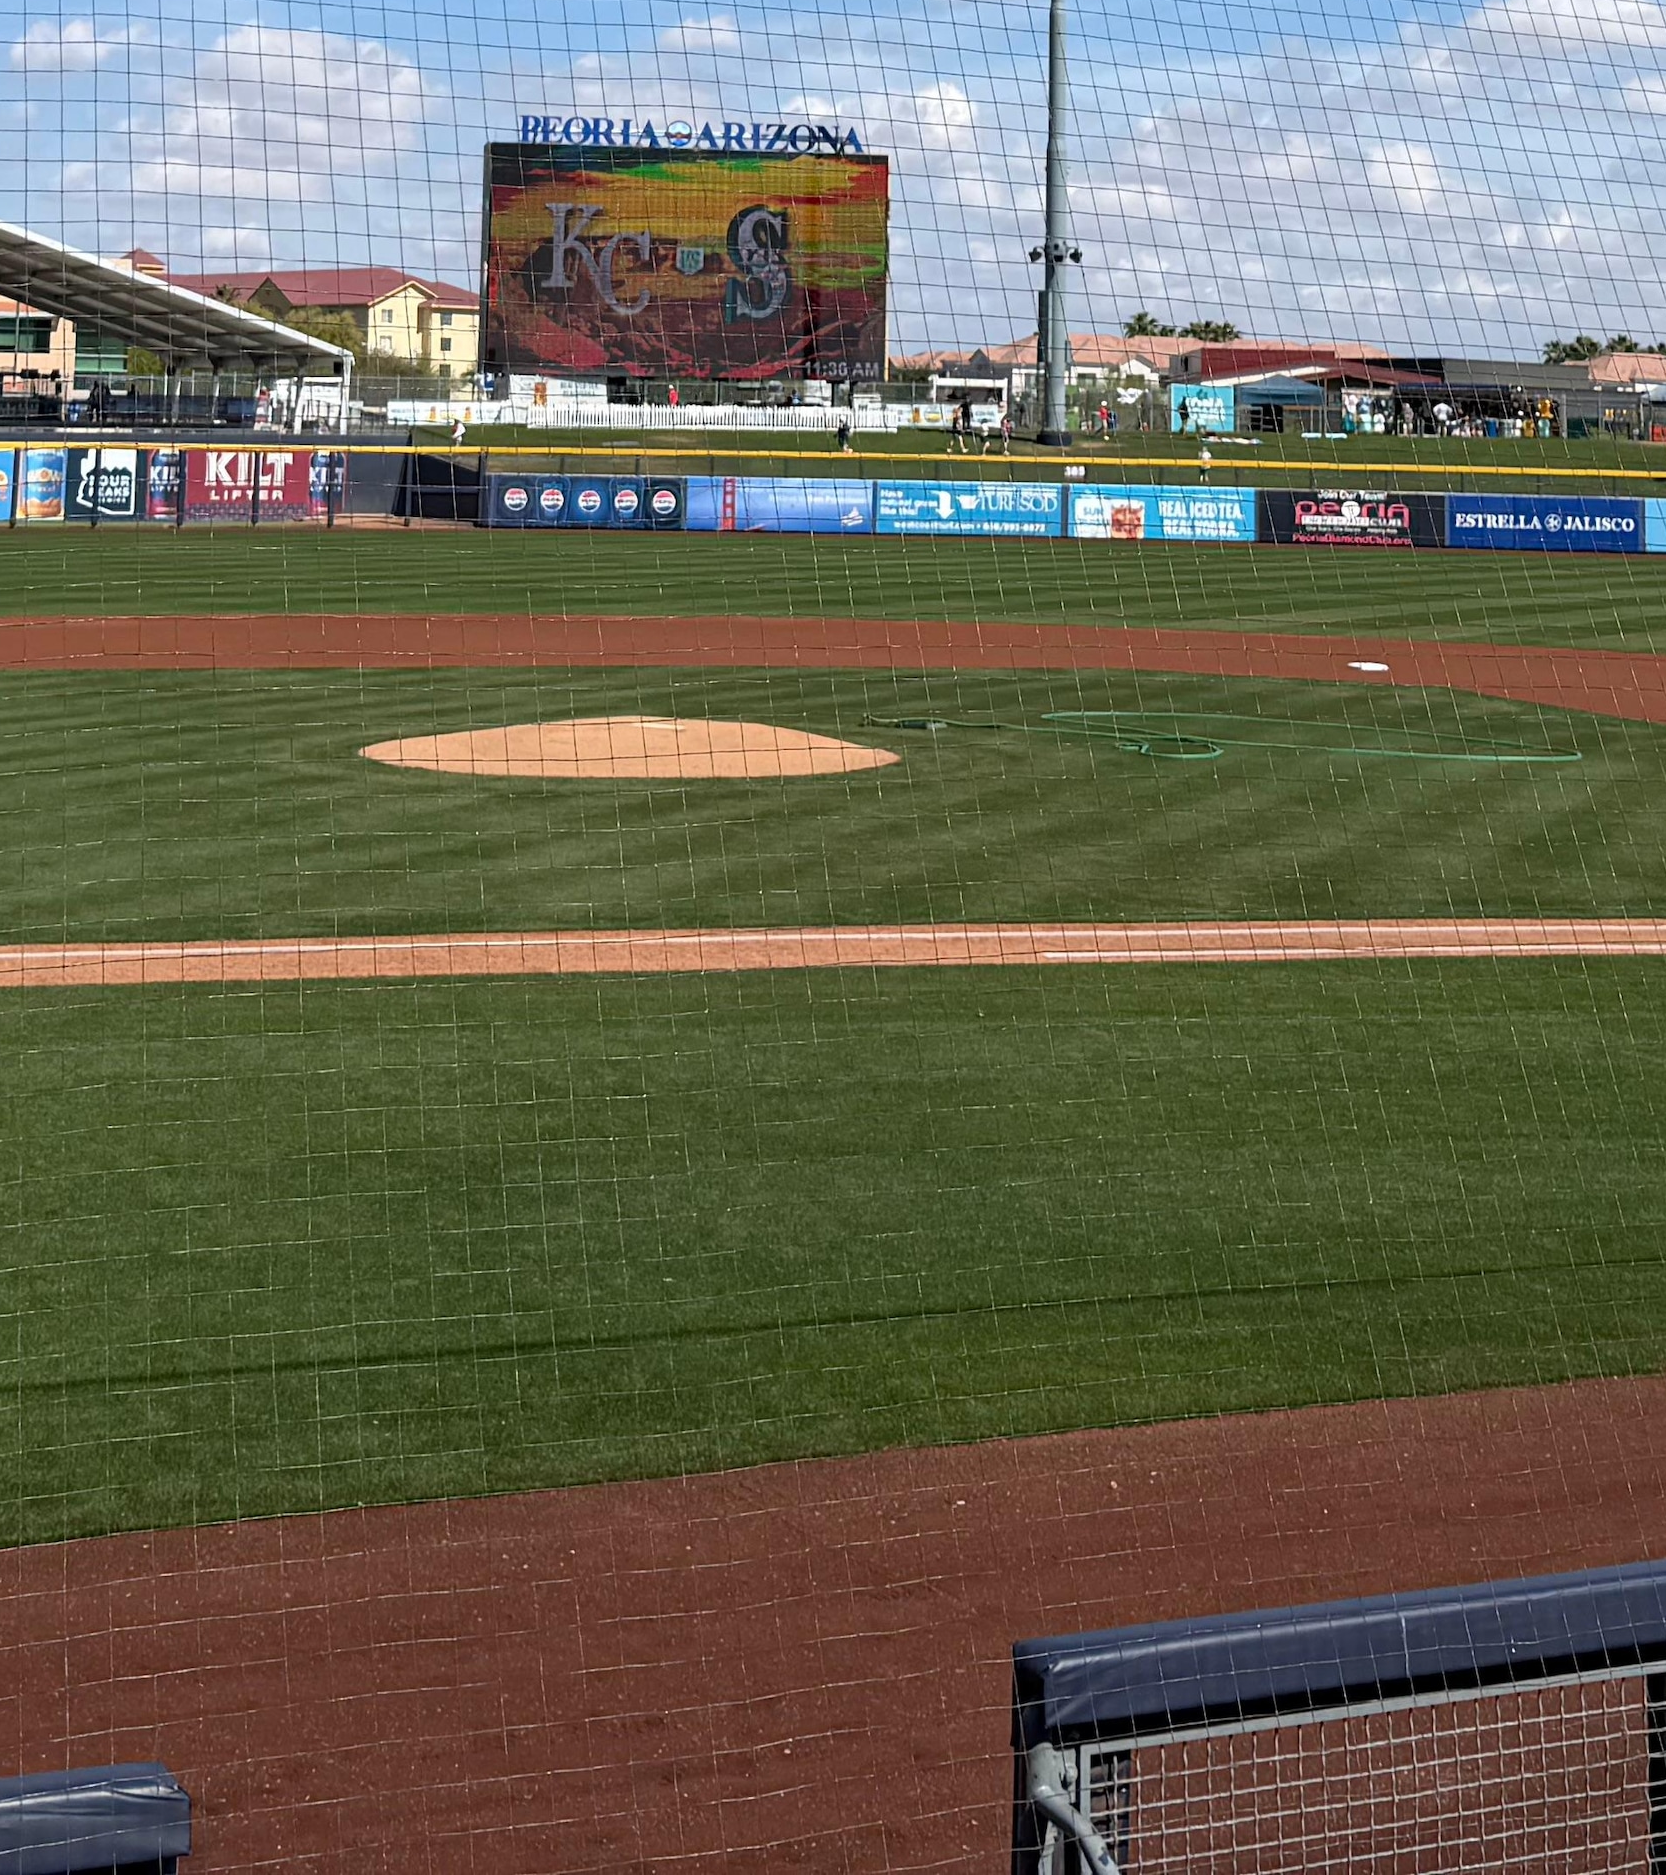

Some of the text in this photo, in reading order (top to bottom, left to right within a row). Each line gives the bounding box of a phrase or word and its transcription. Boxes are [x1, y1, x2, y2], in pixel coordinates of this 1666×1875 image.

[520, 114, 864, 154] PEORIA ARIZONA
[804, 361, 879, 378] 11:30 AM
[205, 451, 293, 486] KILT
[309, 467, 343, 485] KIT
[210, 489, 282, 501] LIFTER
[1455, 512, 1635, 533] ESTRELLA JALISCO
